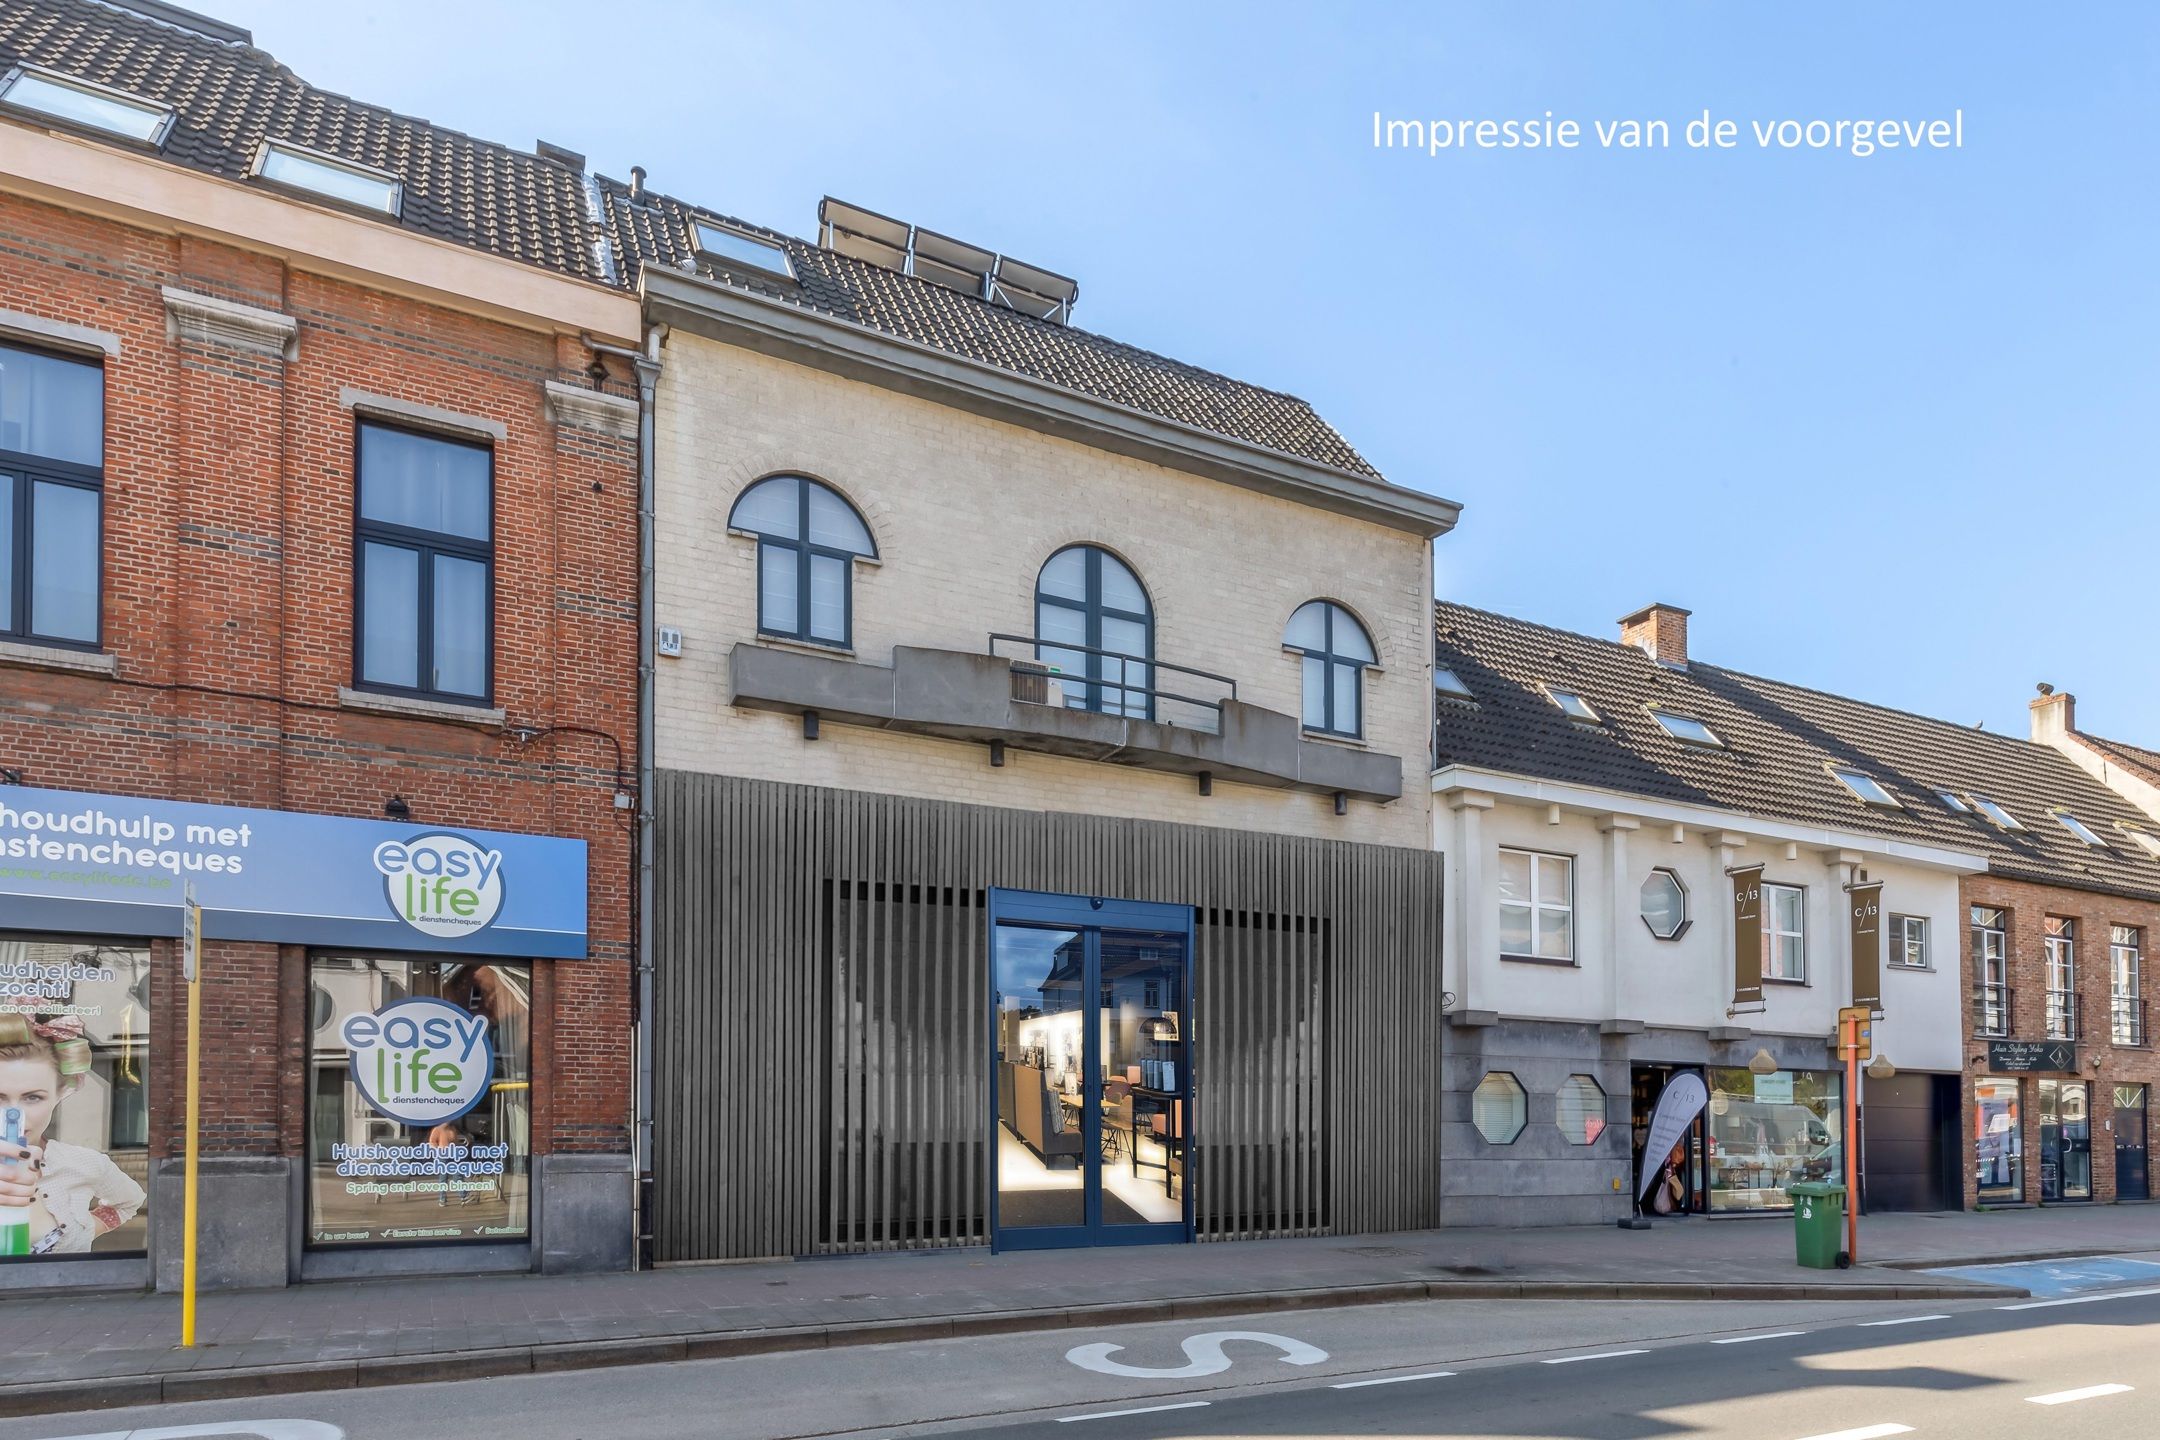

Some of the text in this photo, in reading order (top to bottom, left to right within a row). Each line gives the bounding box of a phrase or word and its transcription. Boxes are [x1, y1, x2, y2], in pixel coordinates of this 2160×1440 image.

[186, 823, 252, 848] met
[0, 833, 243, 875] stencheques
[378, 844, 499, 891] easy
[406, 873, 480, 921] life
[418, 915, 482, 926] dienstencheques
[343, 1014, 485, 1064] easy
[377, 1048, 463, 1104] life
[392, 1096, 466, 1105] dienstencheques
[332, 1142, 508, 1161] Huishoudhulp met
[336, 1158, 504, 1178] dienstencheques
[346, 1182, 388, 1195] Spring
[389, 1180, 417, 1193] snel
